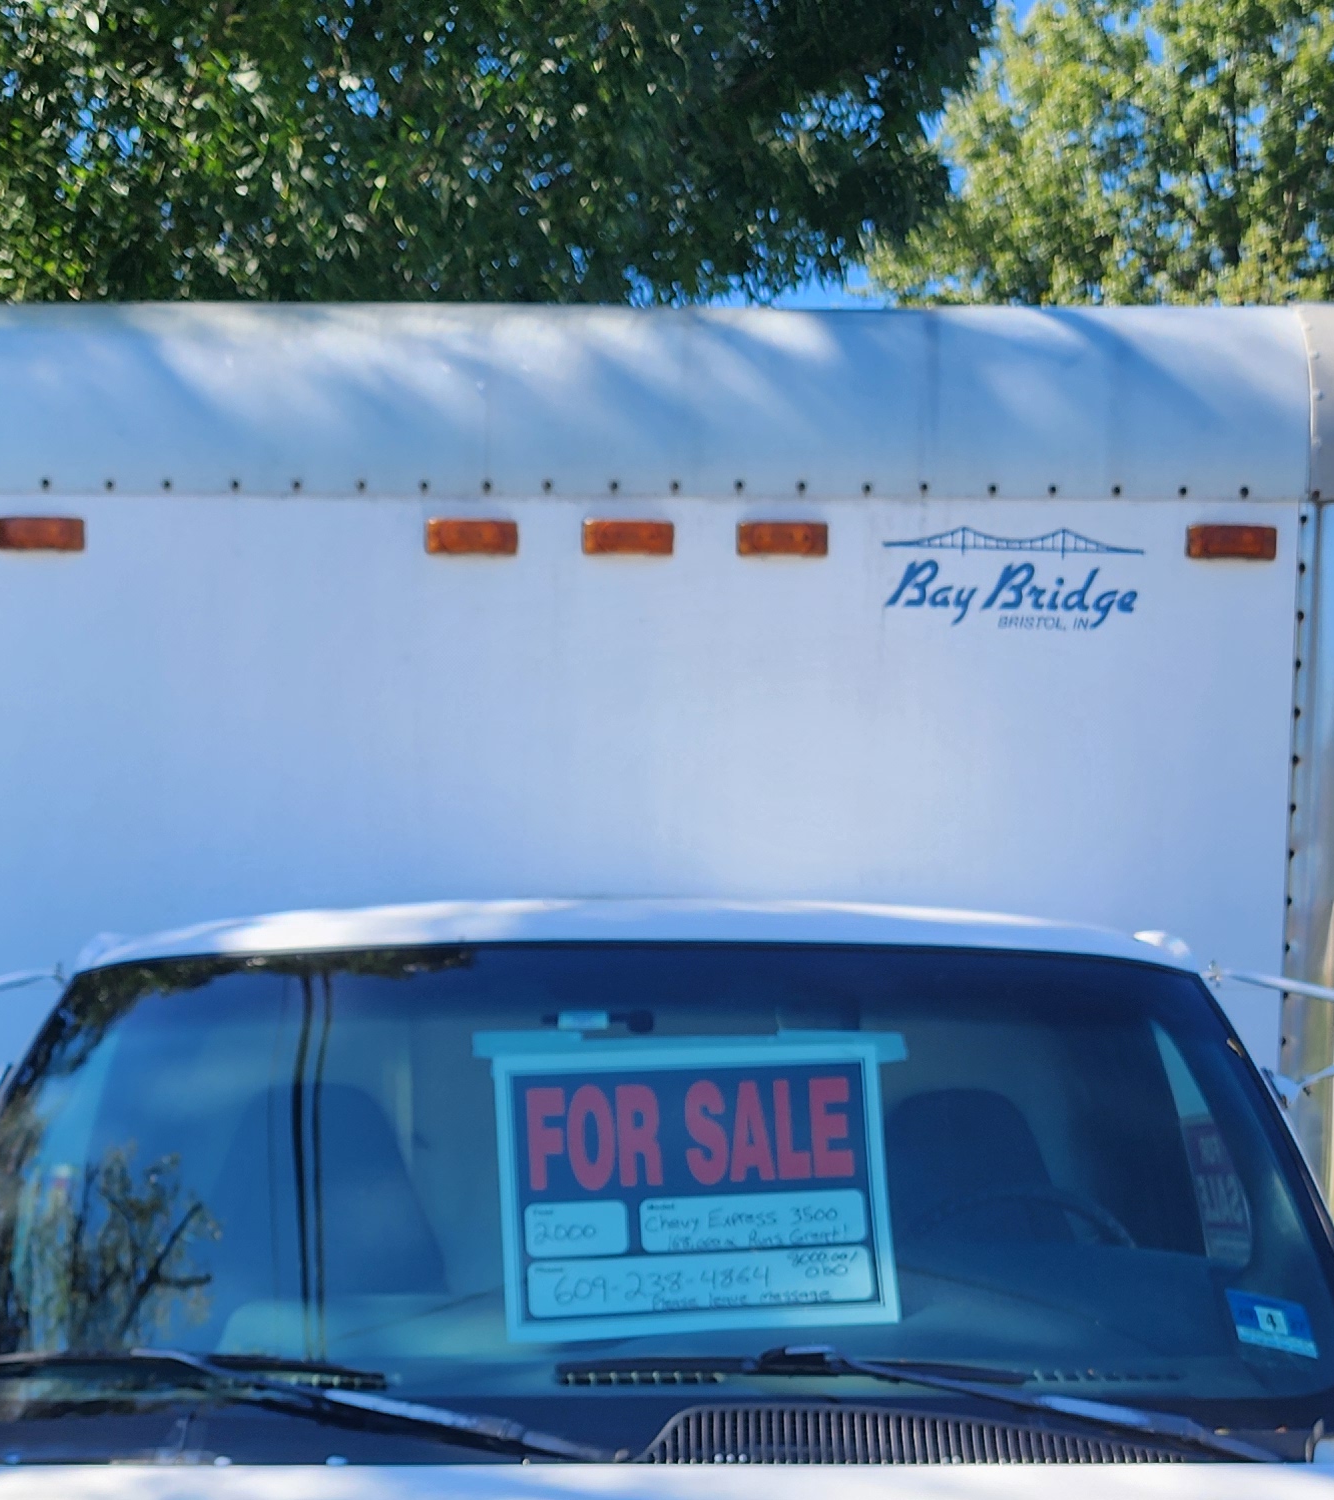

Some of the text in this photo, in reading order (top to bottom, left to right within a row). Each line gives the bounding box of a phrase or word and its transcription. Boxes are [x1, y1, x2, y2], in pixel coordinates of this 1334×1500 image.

[885, 558, 1138, 631] Bay Bridge
[526, 1077, 855, 1191] FOR SALE
[533, 1222, 598, 1246] 2000
[644, 1213, 700, 1233] Chevy
[790, 1205, 839, 1225] 3500
[553, 1264, 770, 1306] 609-238-4864
